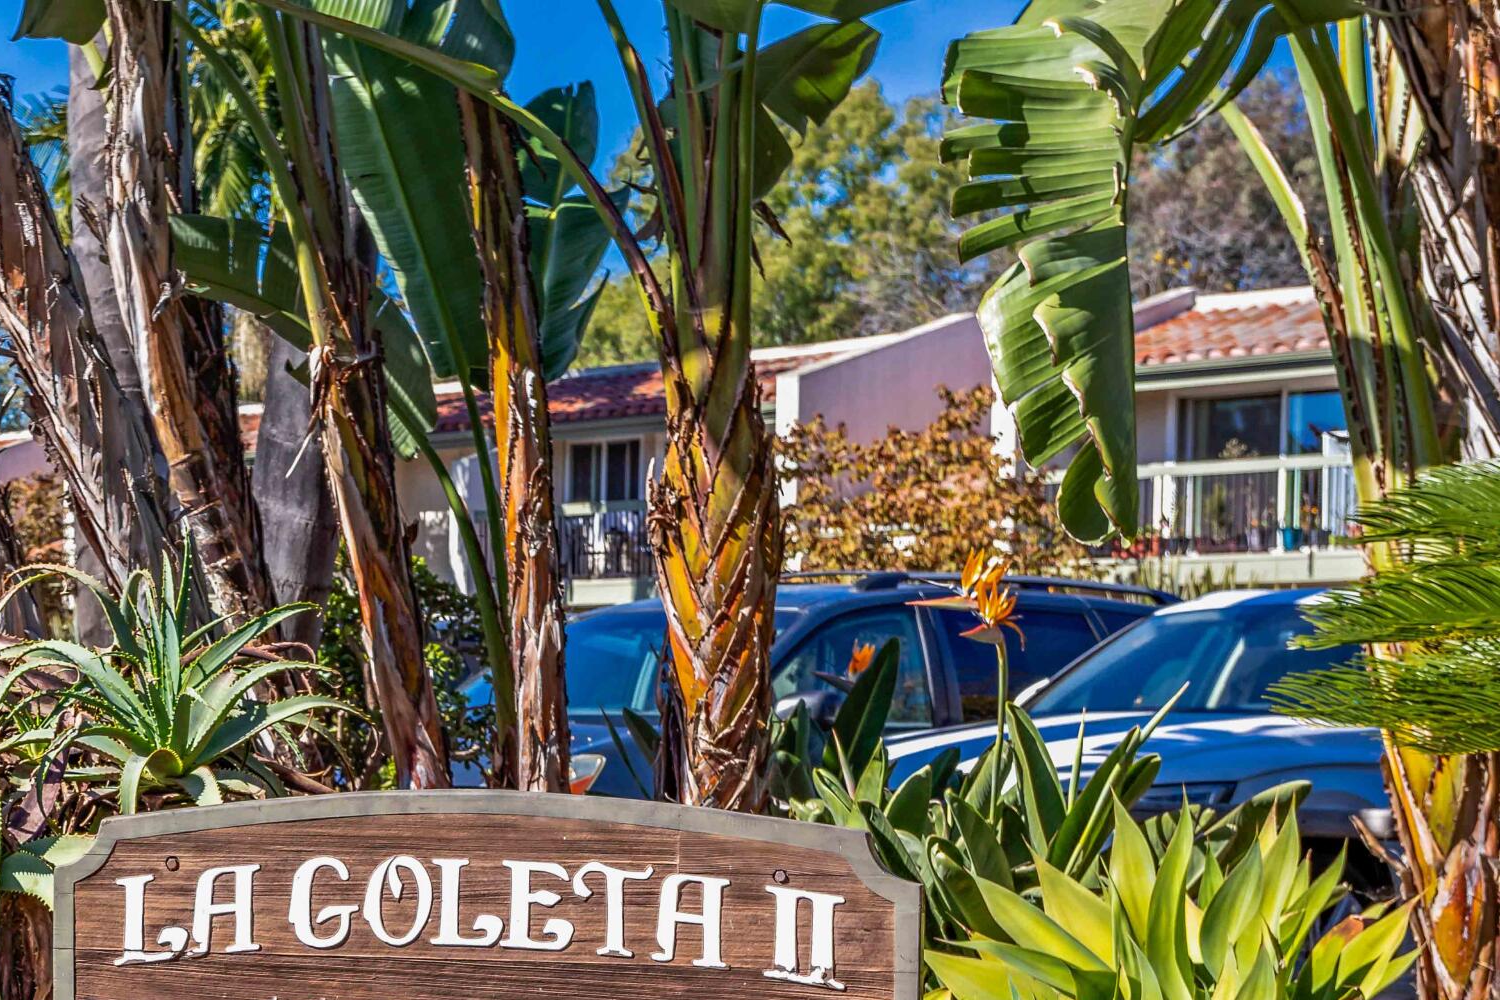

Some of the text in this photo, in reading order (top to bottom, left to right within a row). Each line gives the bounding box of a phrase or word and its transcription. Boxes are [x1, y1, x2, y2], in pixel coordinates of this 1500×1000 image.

[113, 855, 845, 990] LA GOLETA II
